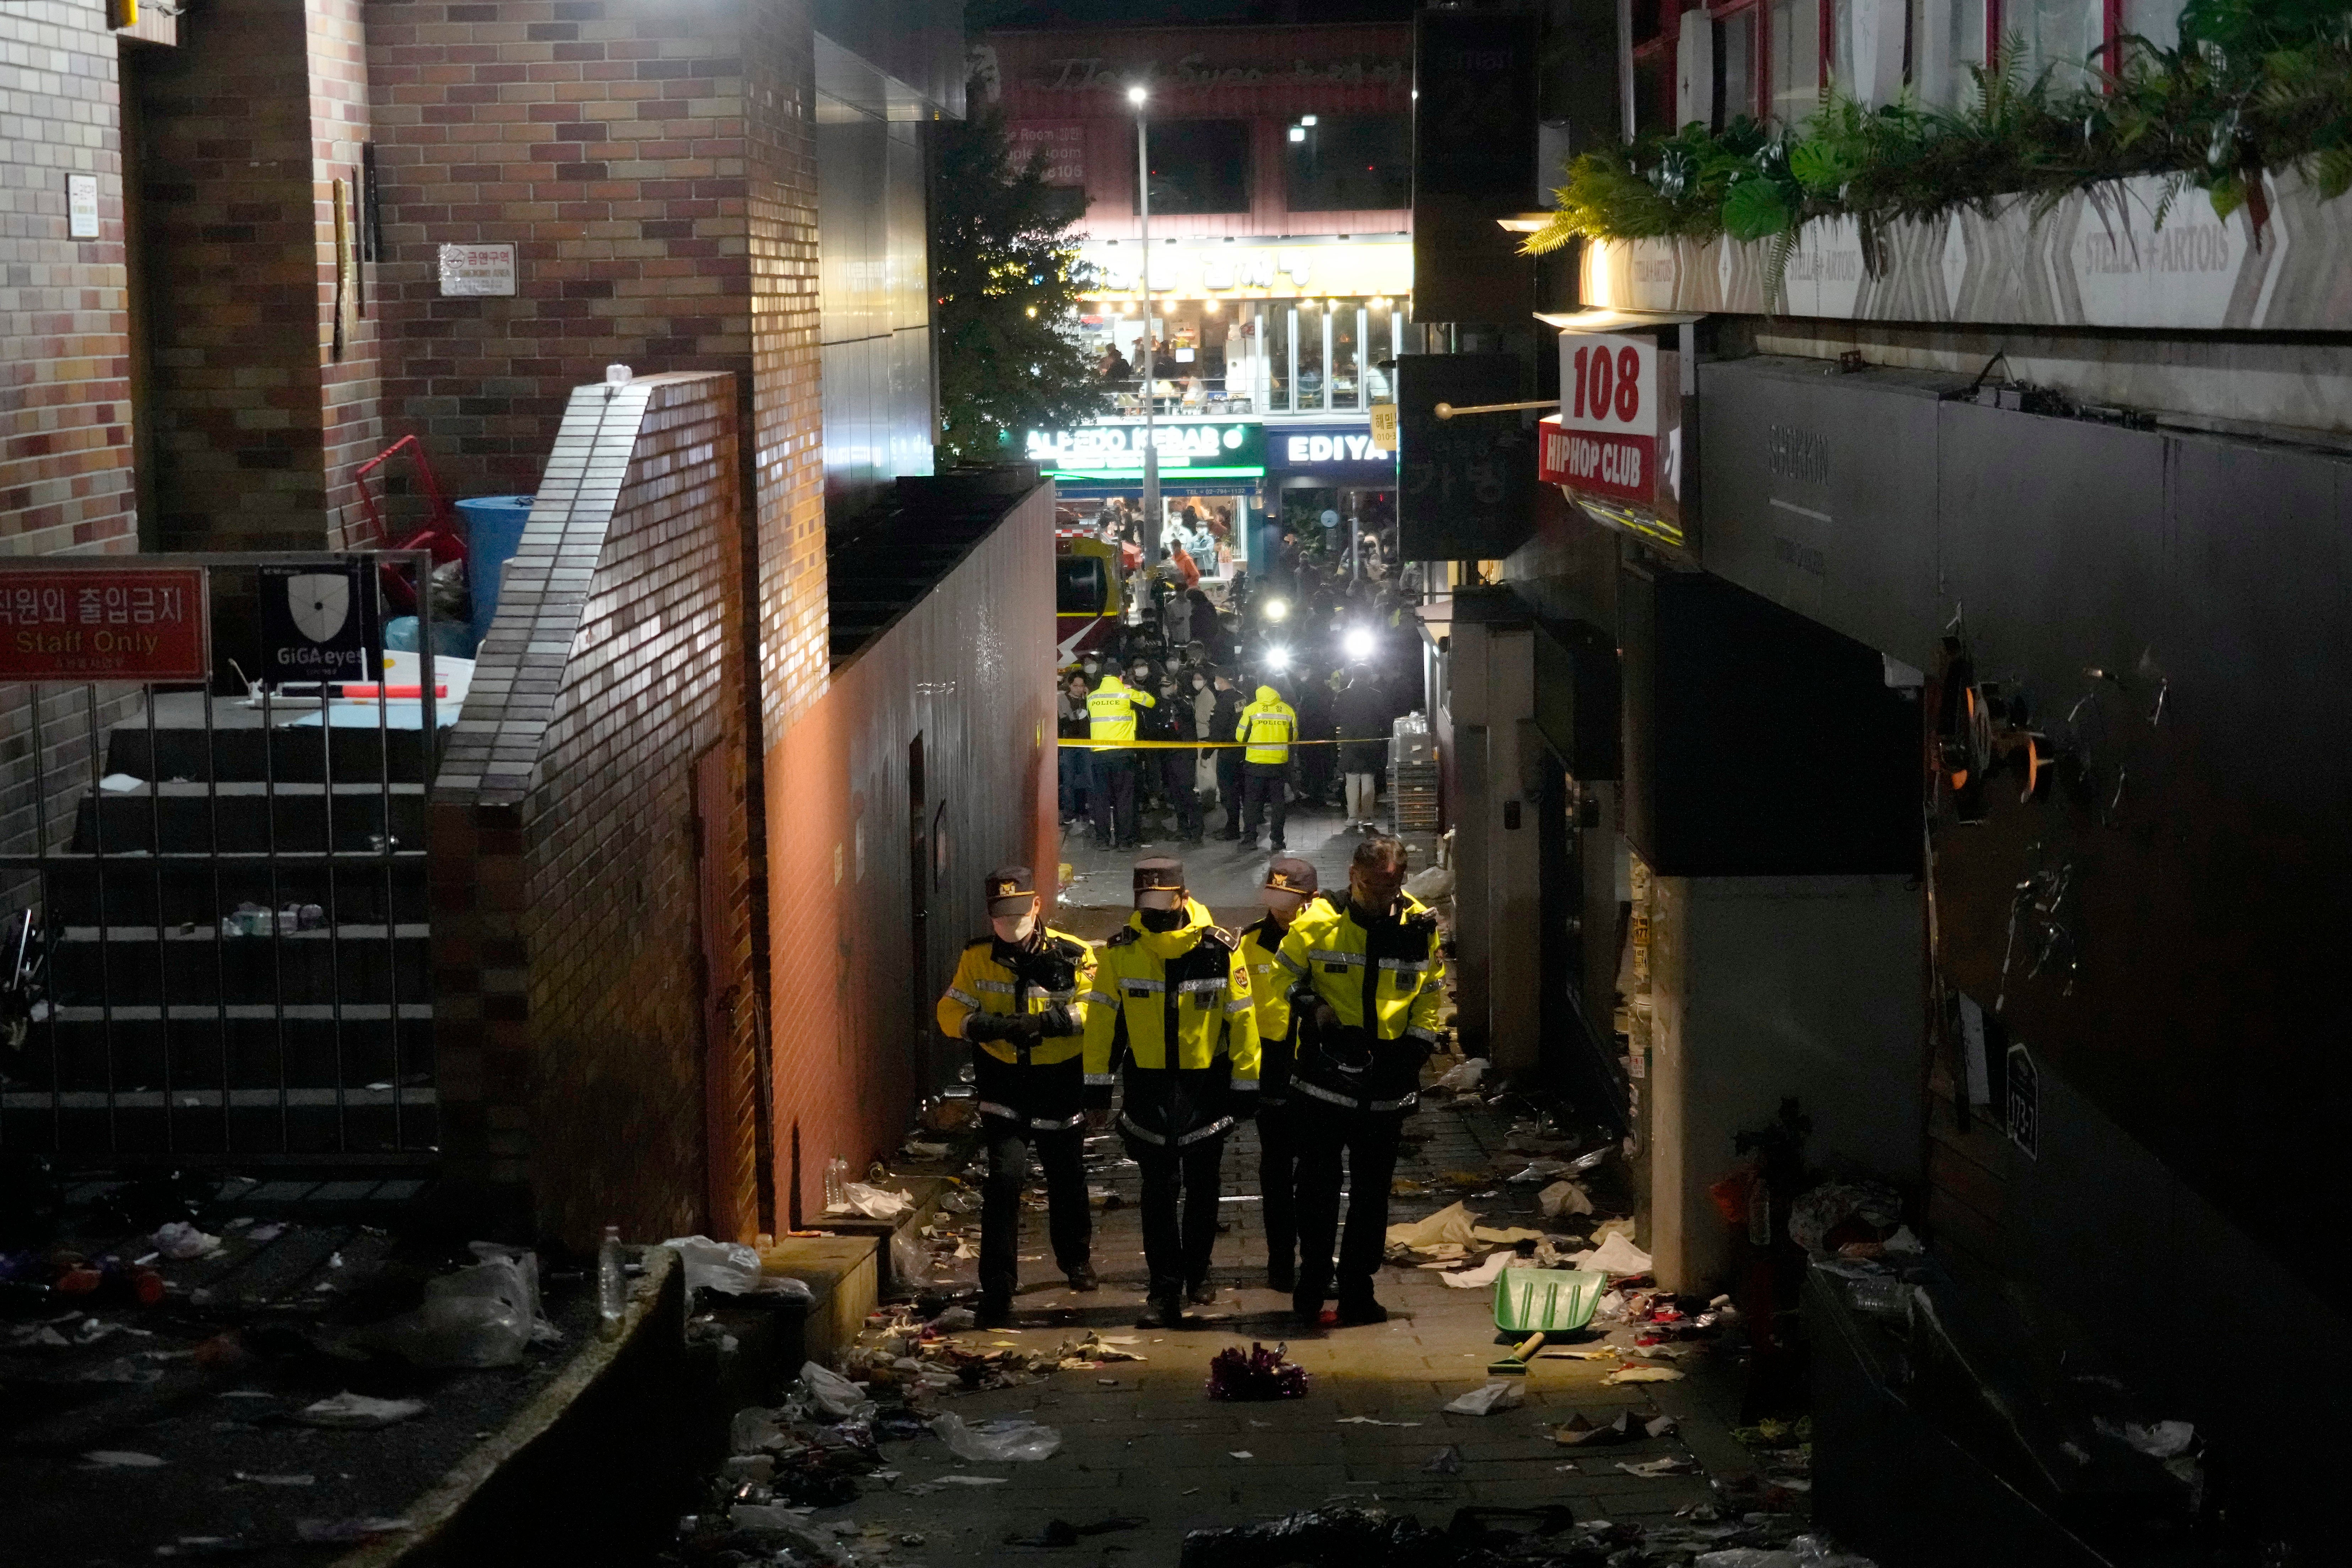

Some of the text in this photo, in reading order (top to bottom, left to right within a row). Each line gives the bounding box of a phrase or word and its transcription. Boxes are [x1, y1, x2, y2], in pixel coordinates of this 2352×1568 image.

[467, 251, 509, 266] 금연구역
[2161, 224, 2229, 272] ARTOIS
[1574, 345, 1640, 422] 108
[1375, 412, 1397, 430] 해밀
[1027, 427, 1219, 452] ALPEDO KEBAB
[1288, 435, 1388, 461] EDIYA
[1546, 433, 1641, 488] HIPHOP CLUB
[79, 587, 182, 624] 출입금지
[16, 630, 158, 655] Staff Only
